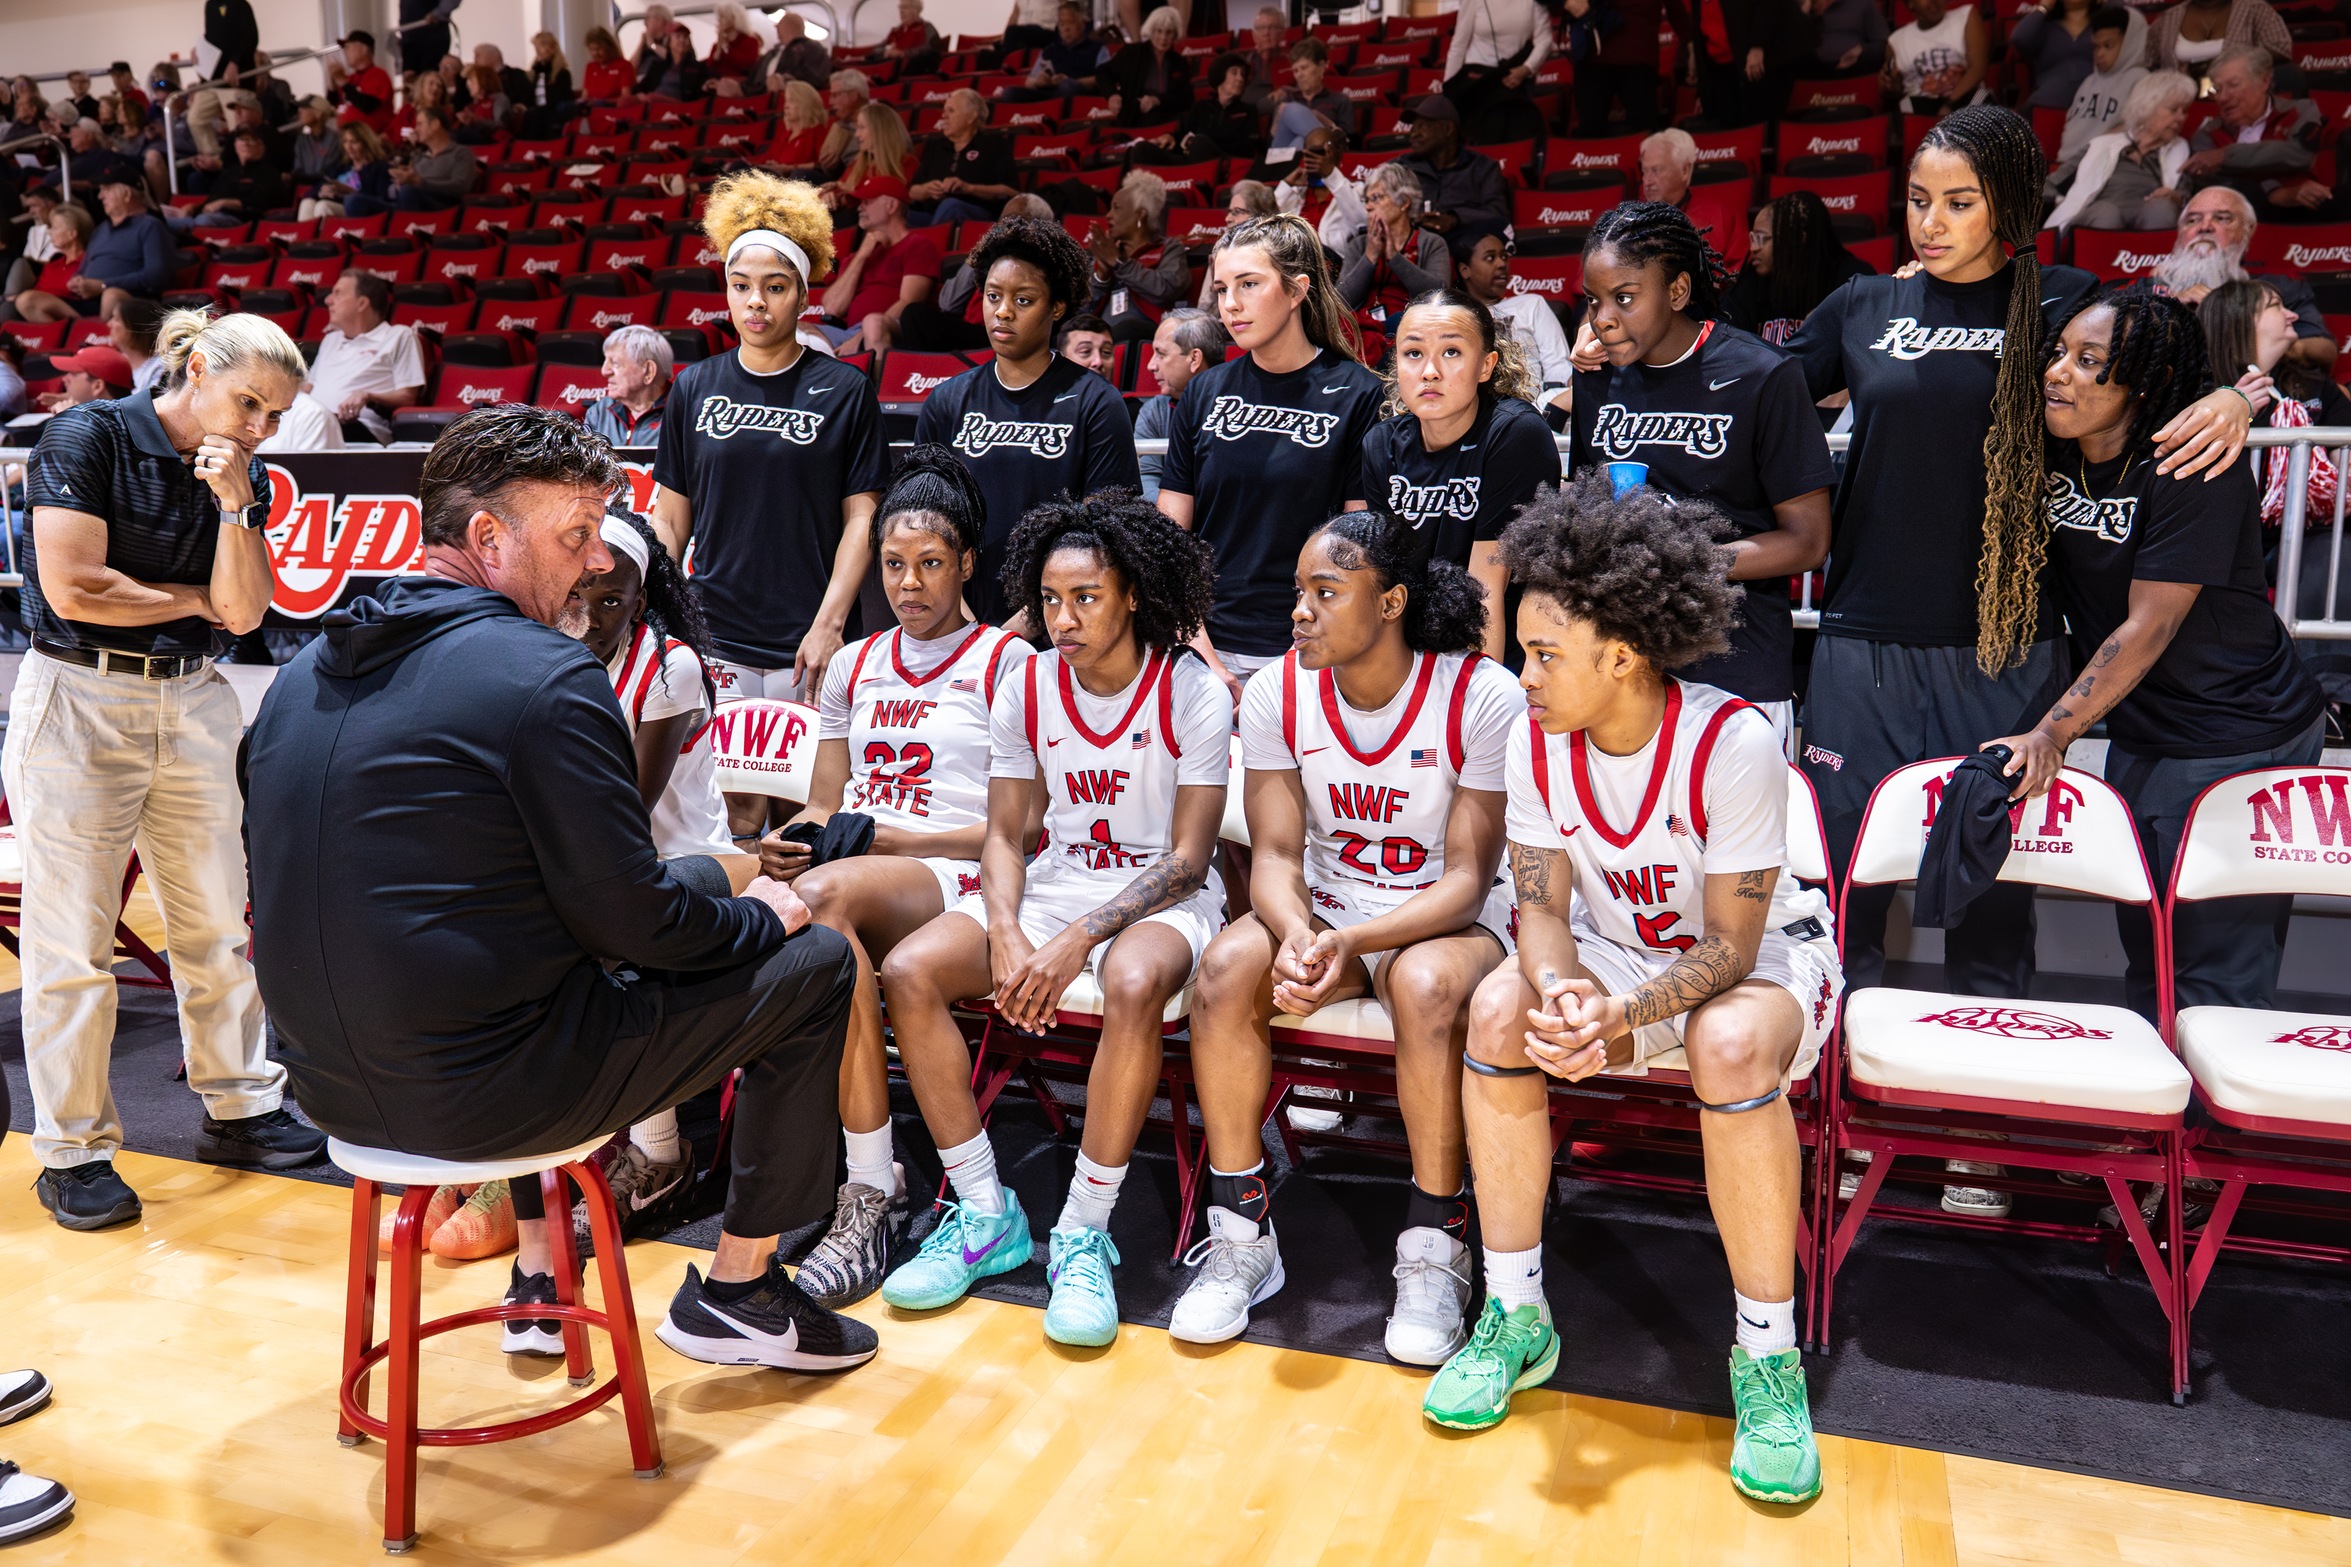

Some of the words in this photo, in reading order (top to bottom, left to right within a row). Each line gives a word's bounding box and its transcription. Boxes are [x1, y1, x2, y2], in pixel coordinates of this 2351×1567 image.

[1506, 274, 1566, 296] RAIDERS
[695, 395, 825, 445] RAIDERS
[952, 412, 1074, 459] RAIDERS
[1202, 396, 1340, 448] RAIDERS
[1591, 403, 1733, 459] RAIDERS
[709, 704, 807, 759] NWF
[870, 699, 938, 729] NWF
[743, 760, 792, 773] COLLEGE
[863, 741, 934, 786] 22
[1803, 744, 1844, 771] RAIDERS
[852, 780, 933, 818] STATE
[1065, 769, 1130, 805] NWF
[1328, 783, 1409, 824] NWF
[1329, 829, 1429, 876] 20
[2012, 838, 2073, 854] LLEGE
[2254, 846, 2317, 863] STATE
[1632, 911, 1698, 954] 5
[1910, 1011, 2115, 1041] RAIDERS
